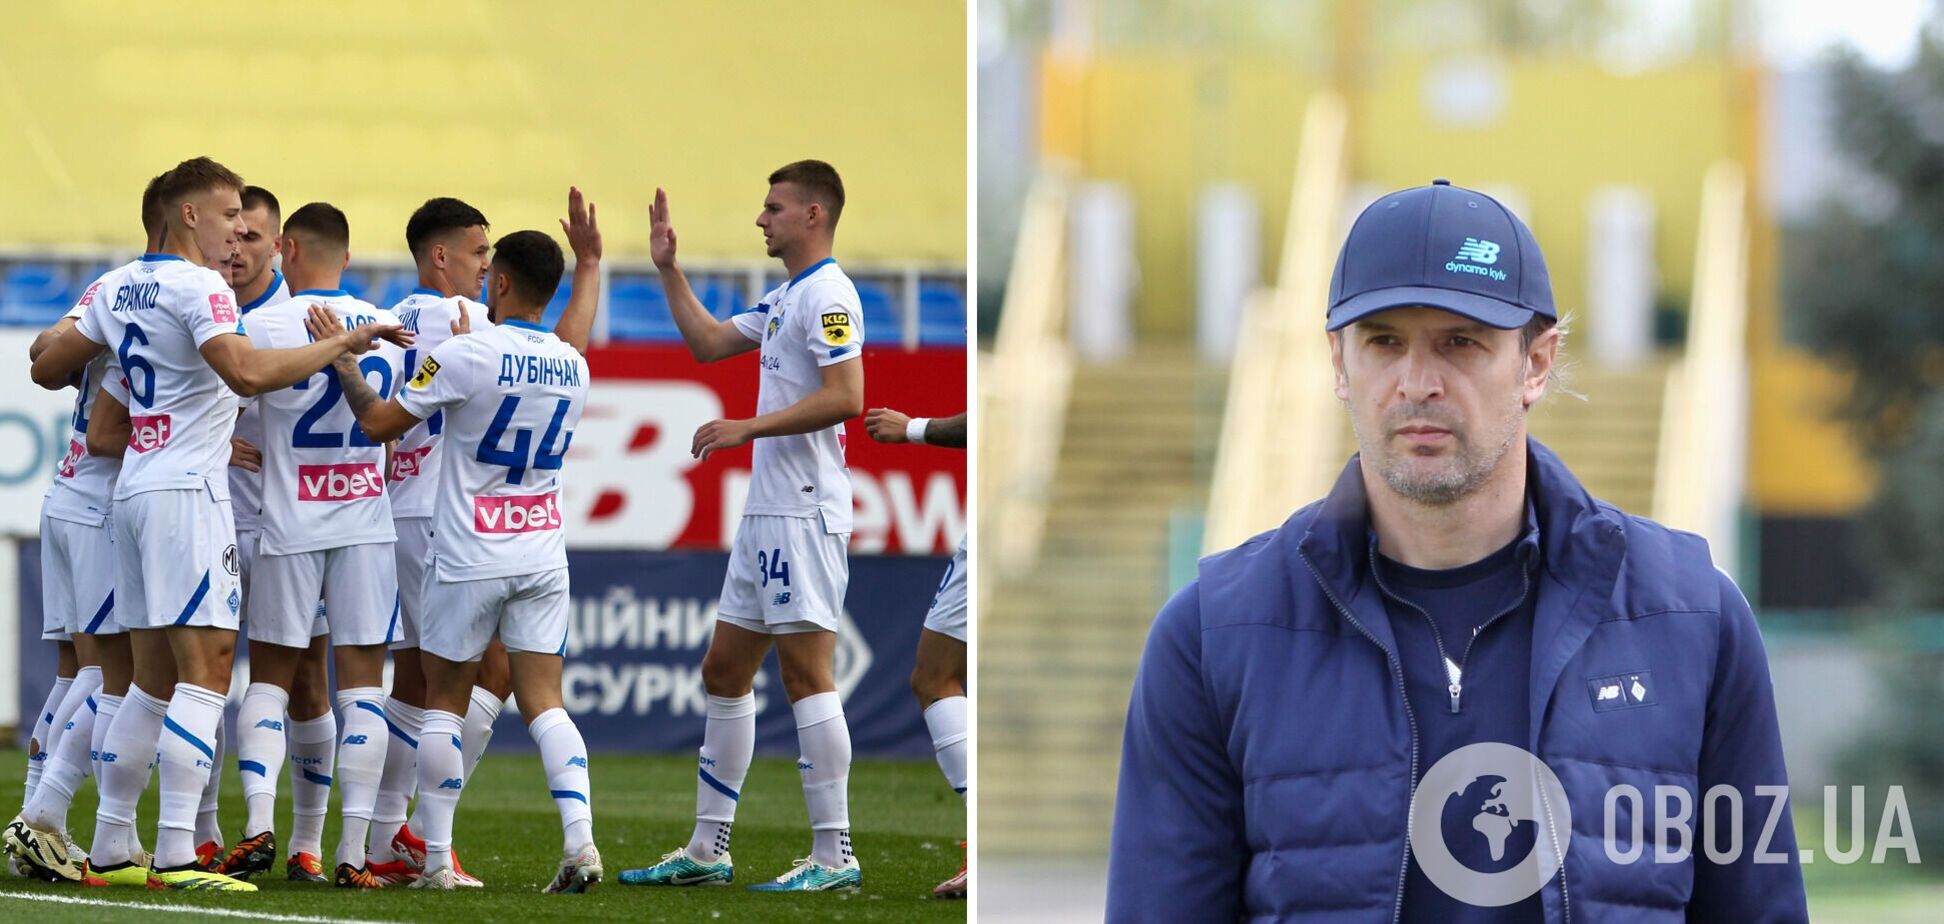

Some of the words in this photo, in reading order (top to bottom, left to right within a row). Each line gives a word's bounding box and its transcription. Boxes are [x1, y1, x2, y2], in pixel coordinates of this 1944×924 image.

[1445, 261, 1488, 276] dynamo
[1489, 267, 1507, 281] kyiv
[112, 281, 160, 312] БРАЖКО
[118, 322, 156, 409] 6
[498, 353, 581, 387] ДУБІНЧАК
[476, 395, 573, 486] 44
[303, 467, 382, 497] vbet
[479, 498, 560, 530] vbet
[758, 549, 790, 588] 34
